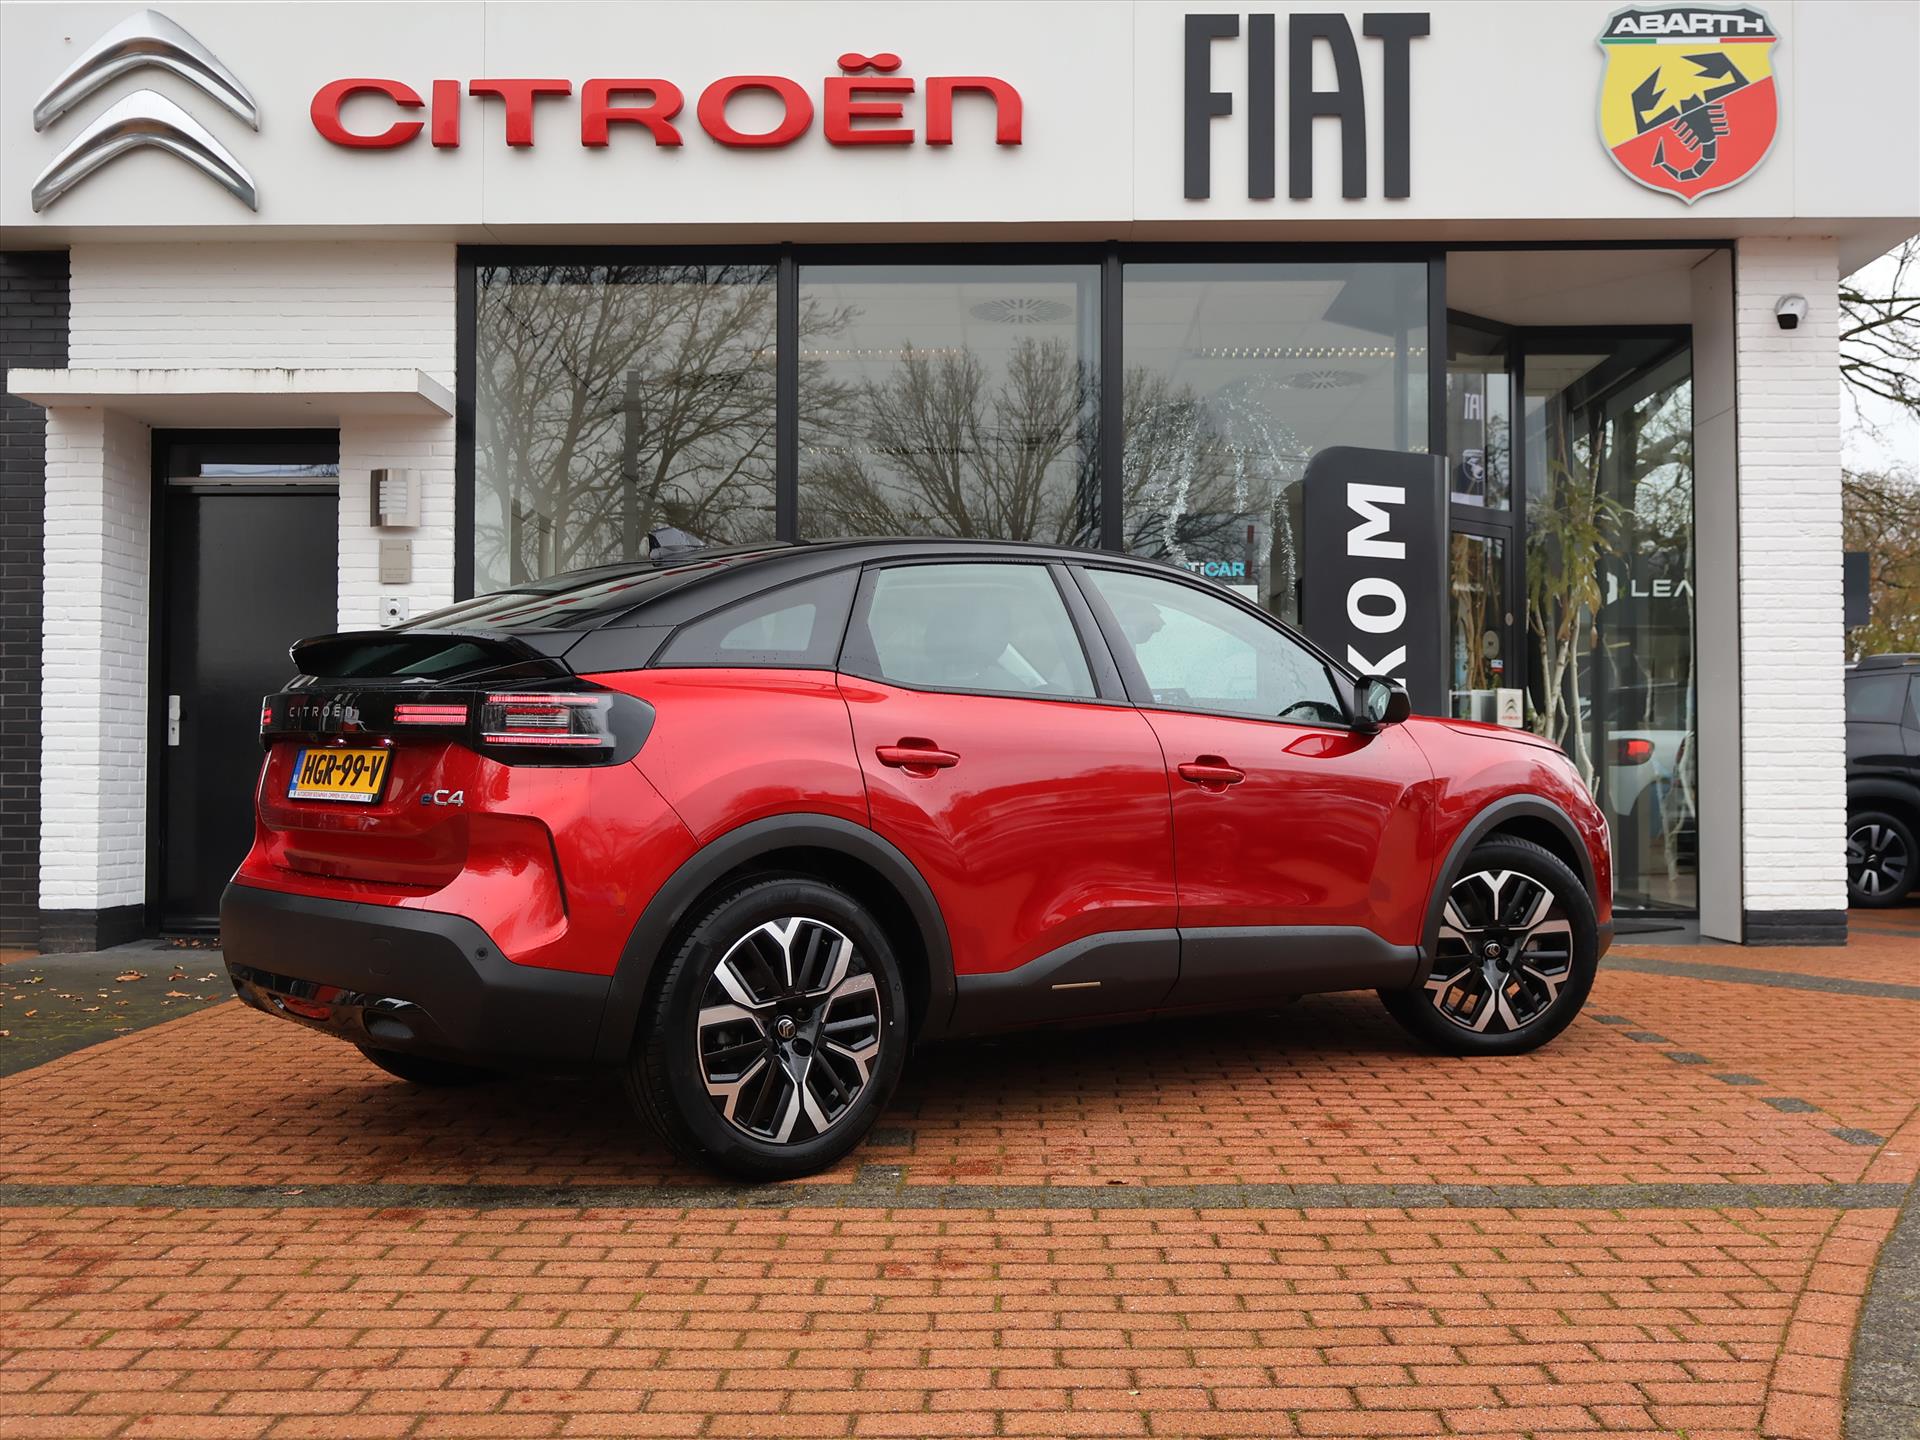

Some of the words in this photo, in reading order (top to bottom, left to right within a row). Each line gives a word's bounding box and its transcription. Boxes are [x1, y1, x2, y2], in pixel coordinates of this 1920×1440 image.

[1612, 12, 1764, 35] ABARTH
[1184, 12, 1431, 201] FIAT
[301, 754, 384, 788] HGR-99-V
[421, 789, 465, 807] eC4
